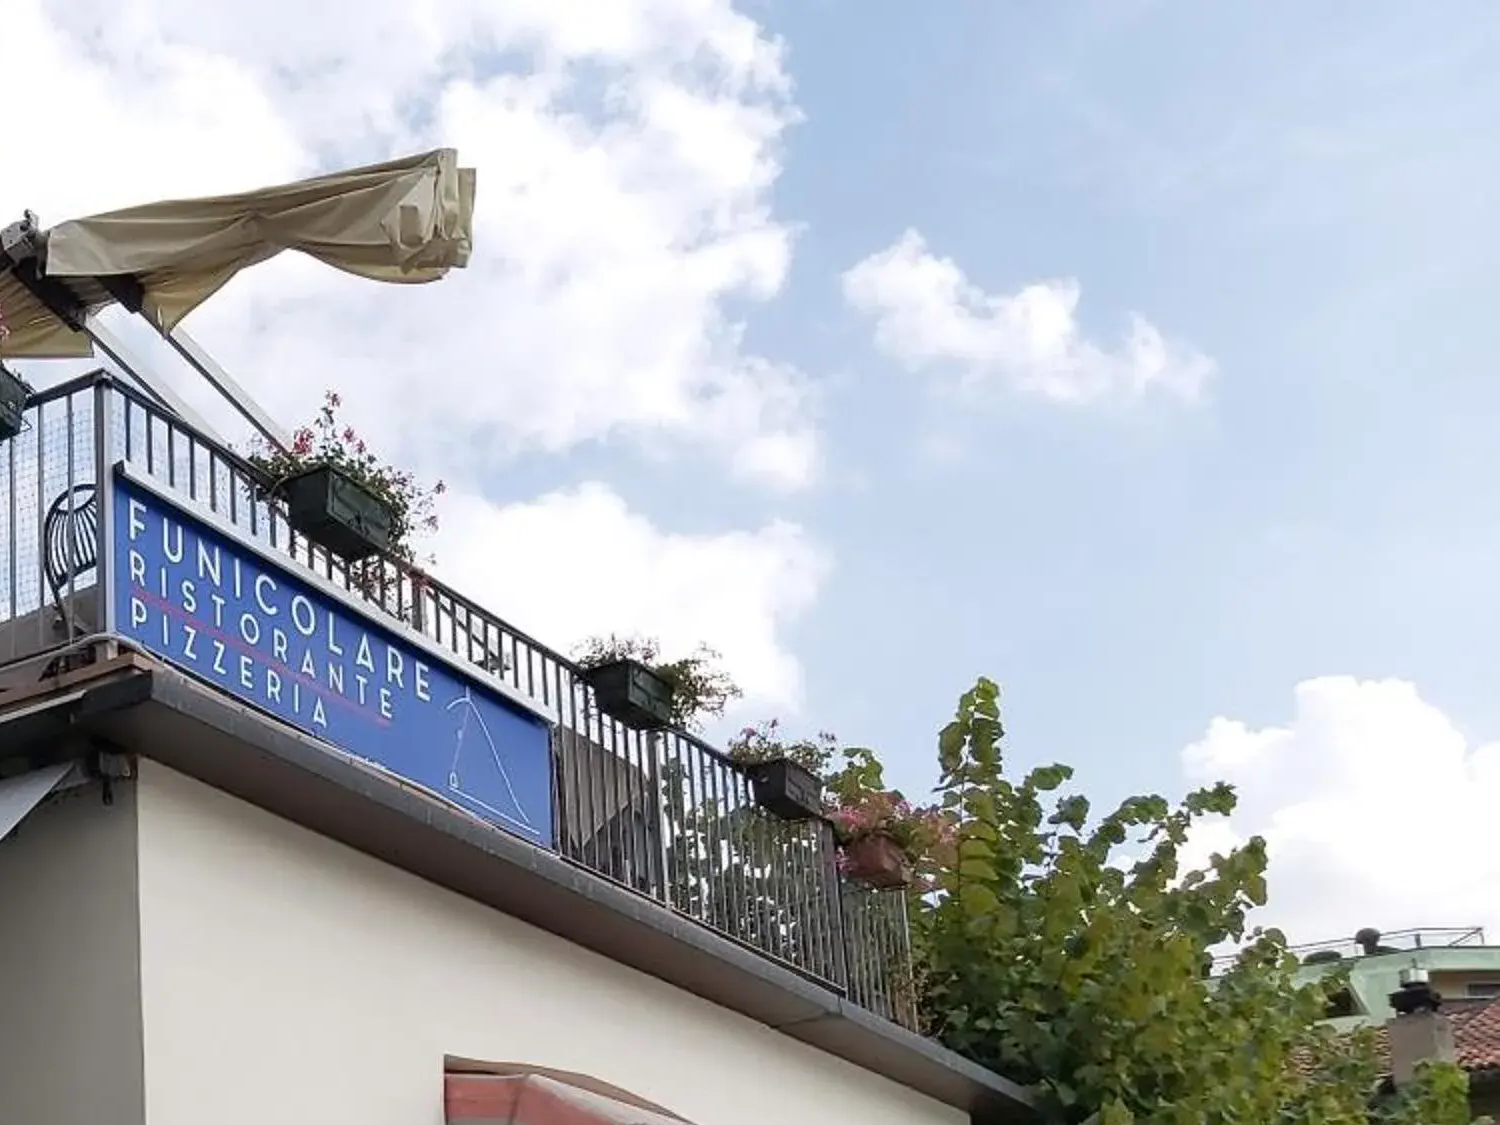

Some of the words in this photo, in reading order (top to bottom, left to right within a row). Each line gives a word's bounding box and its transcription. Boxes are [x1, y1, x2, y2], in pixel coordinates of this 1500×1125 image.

[128, 499, 431, 701] FUNICOLARE
[129, 550, 392, 719] RISTORANTE
[132, 597, 327, 729] PIZZERIA
